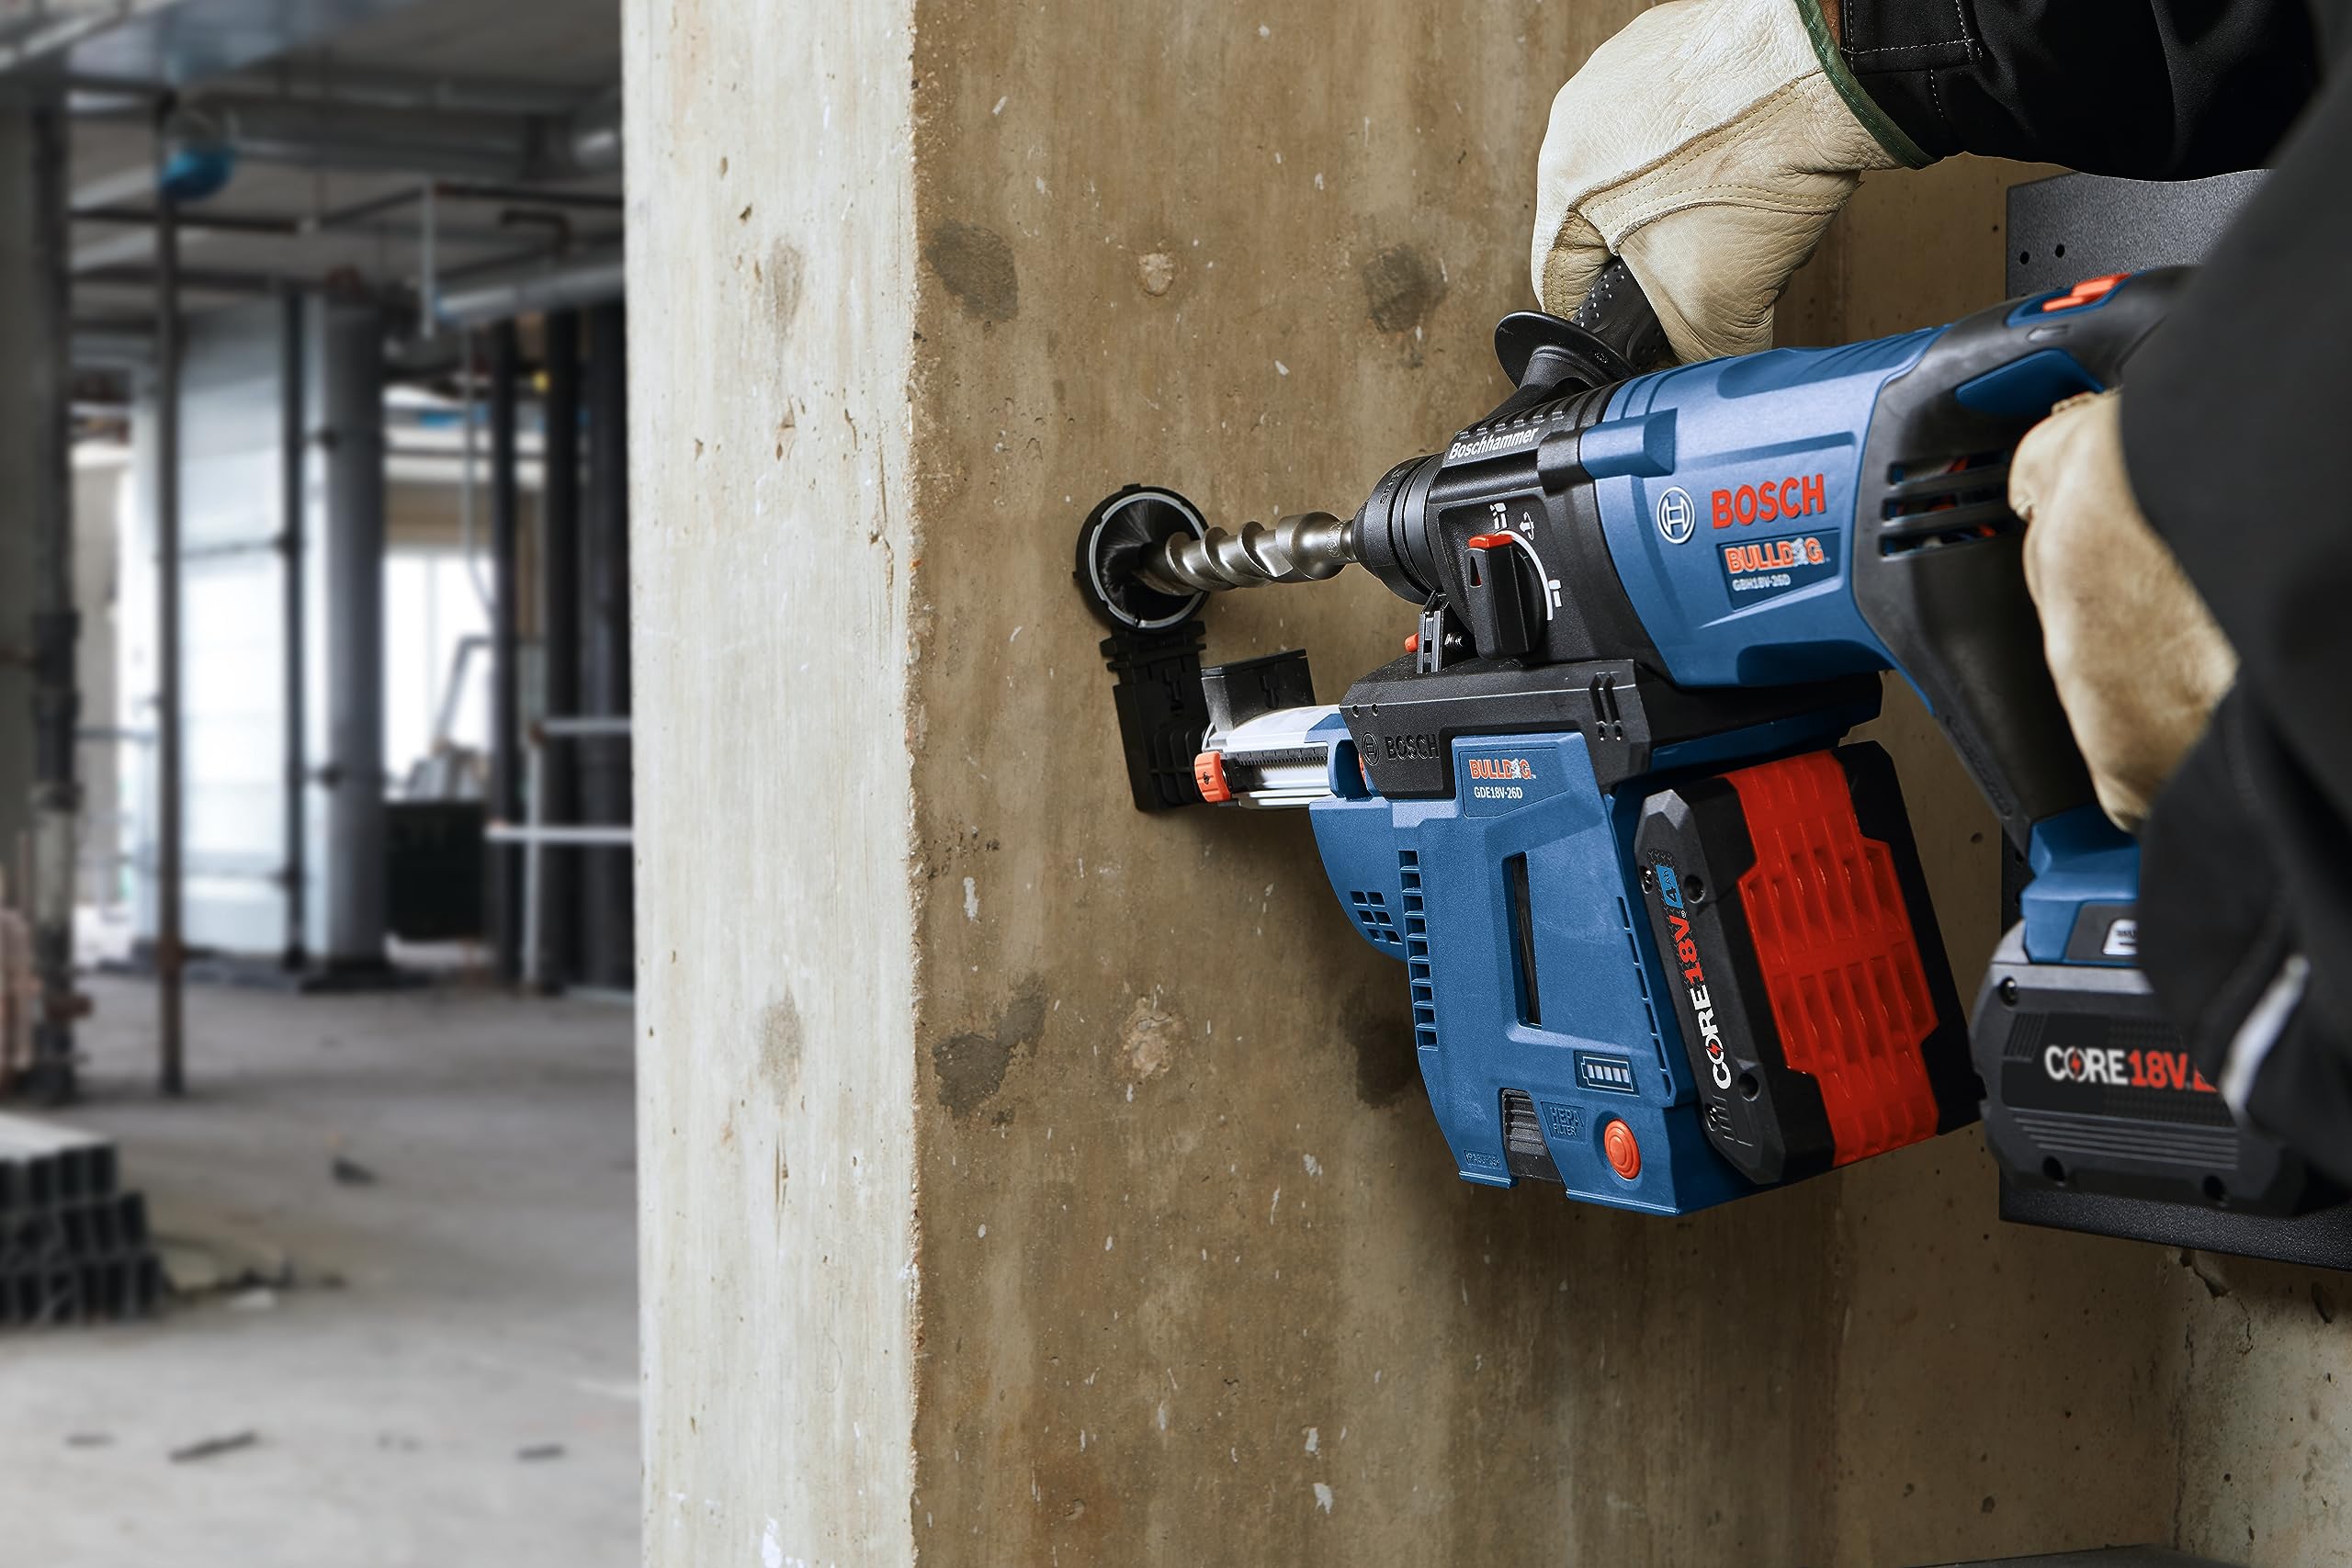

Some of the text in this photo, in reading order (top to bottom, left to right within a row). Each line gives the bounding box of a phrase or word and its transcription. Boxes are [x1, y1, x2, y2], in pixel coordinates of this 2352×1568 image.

[1449, 427, 1540, 460] Boschhammer
[1711, 473, 1826, 530] BOSCH
[1724, 536, 1825, 574] BULLDG
[1384, 734, 1440, 761] BOSCH
[1468, 758, 1532, 780] BULLDG
[1549, 1106, 1585, 1128] HEPA
[1553, 1122, 1579, 1137] FILTER
